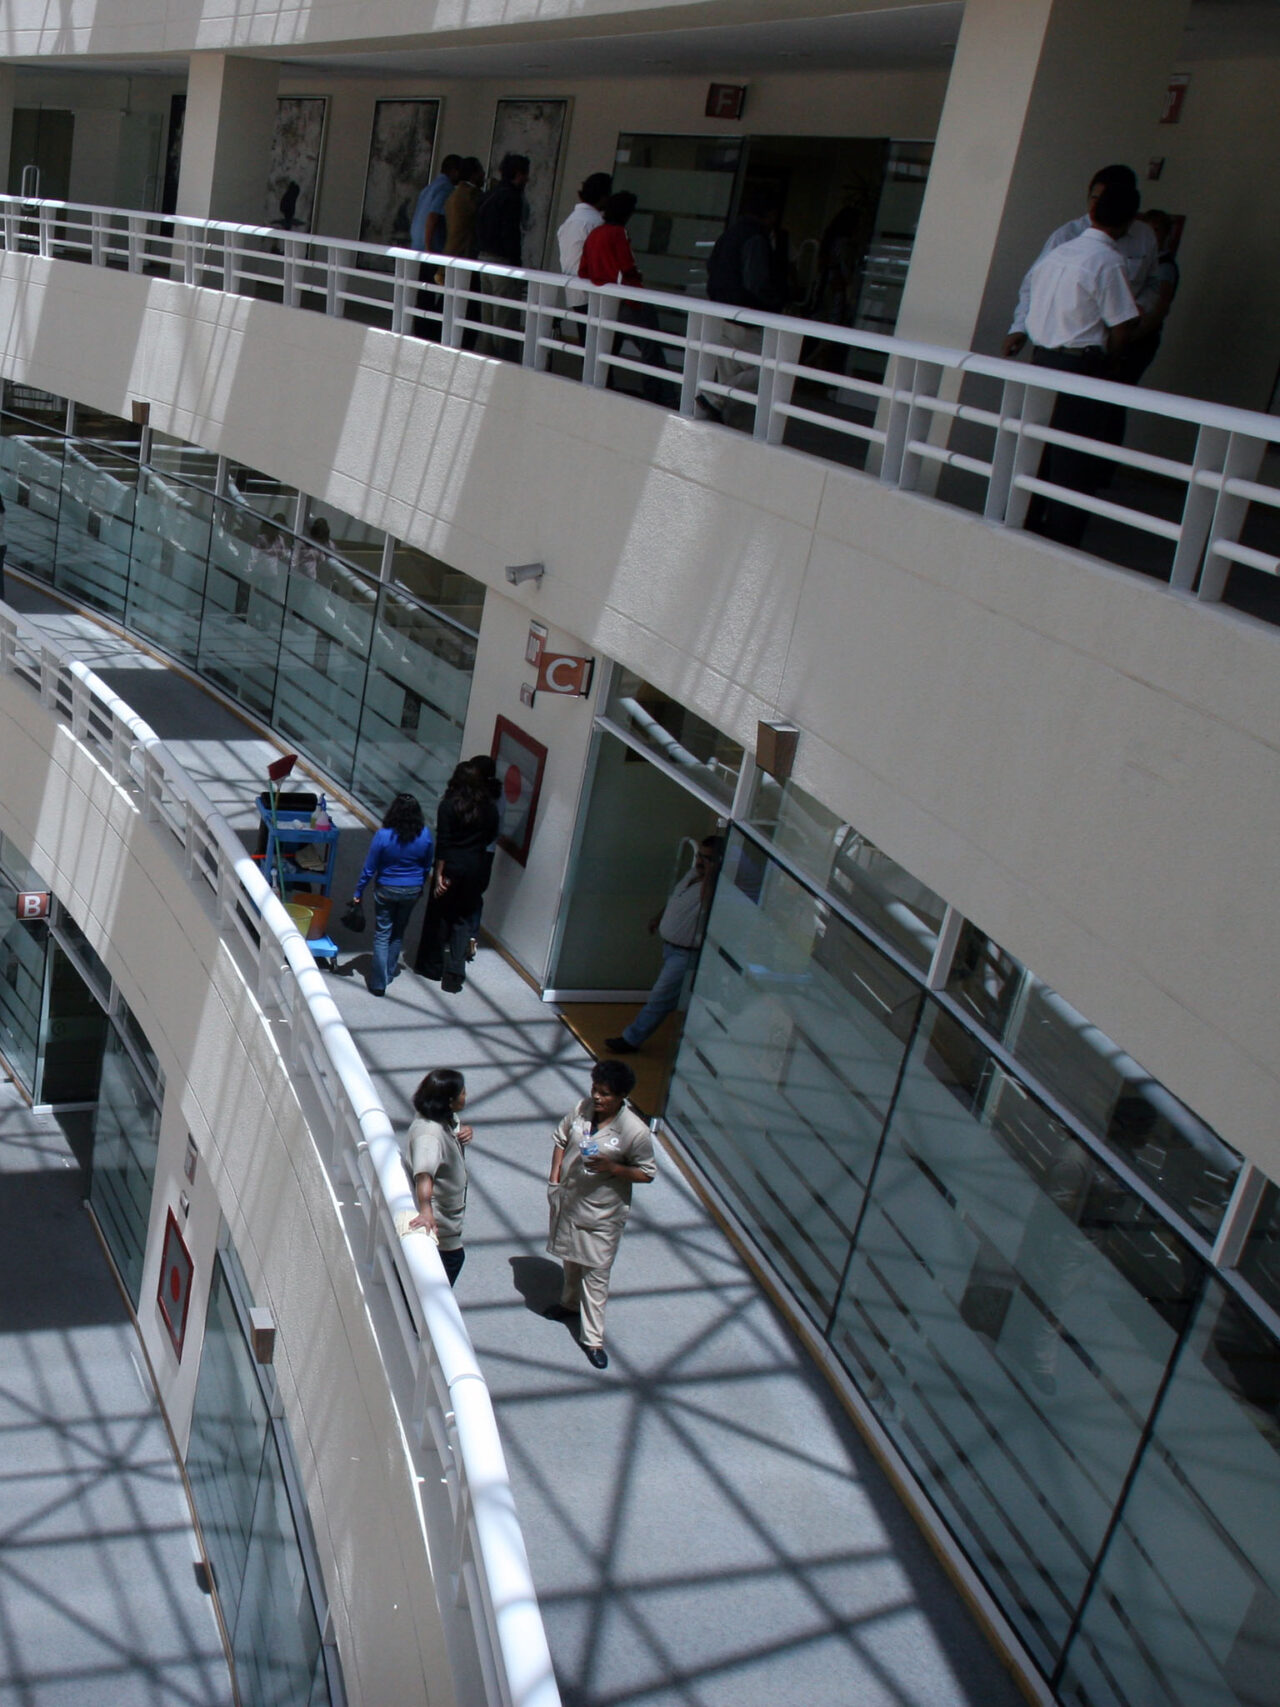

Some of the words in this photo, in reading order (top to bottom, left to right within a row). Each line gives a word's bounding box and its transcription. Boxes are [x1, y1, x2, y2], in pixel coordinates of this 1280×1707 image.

[715, 89, 733, 114] F
[546, 658, 578, 692] C
[25, 896, 41, 917] B
